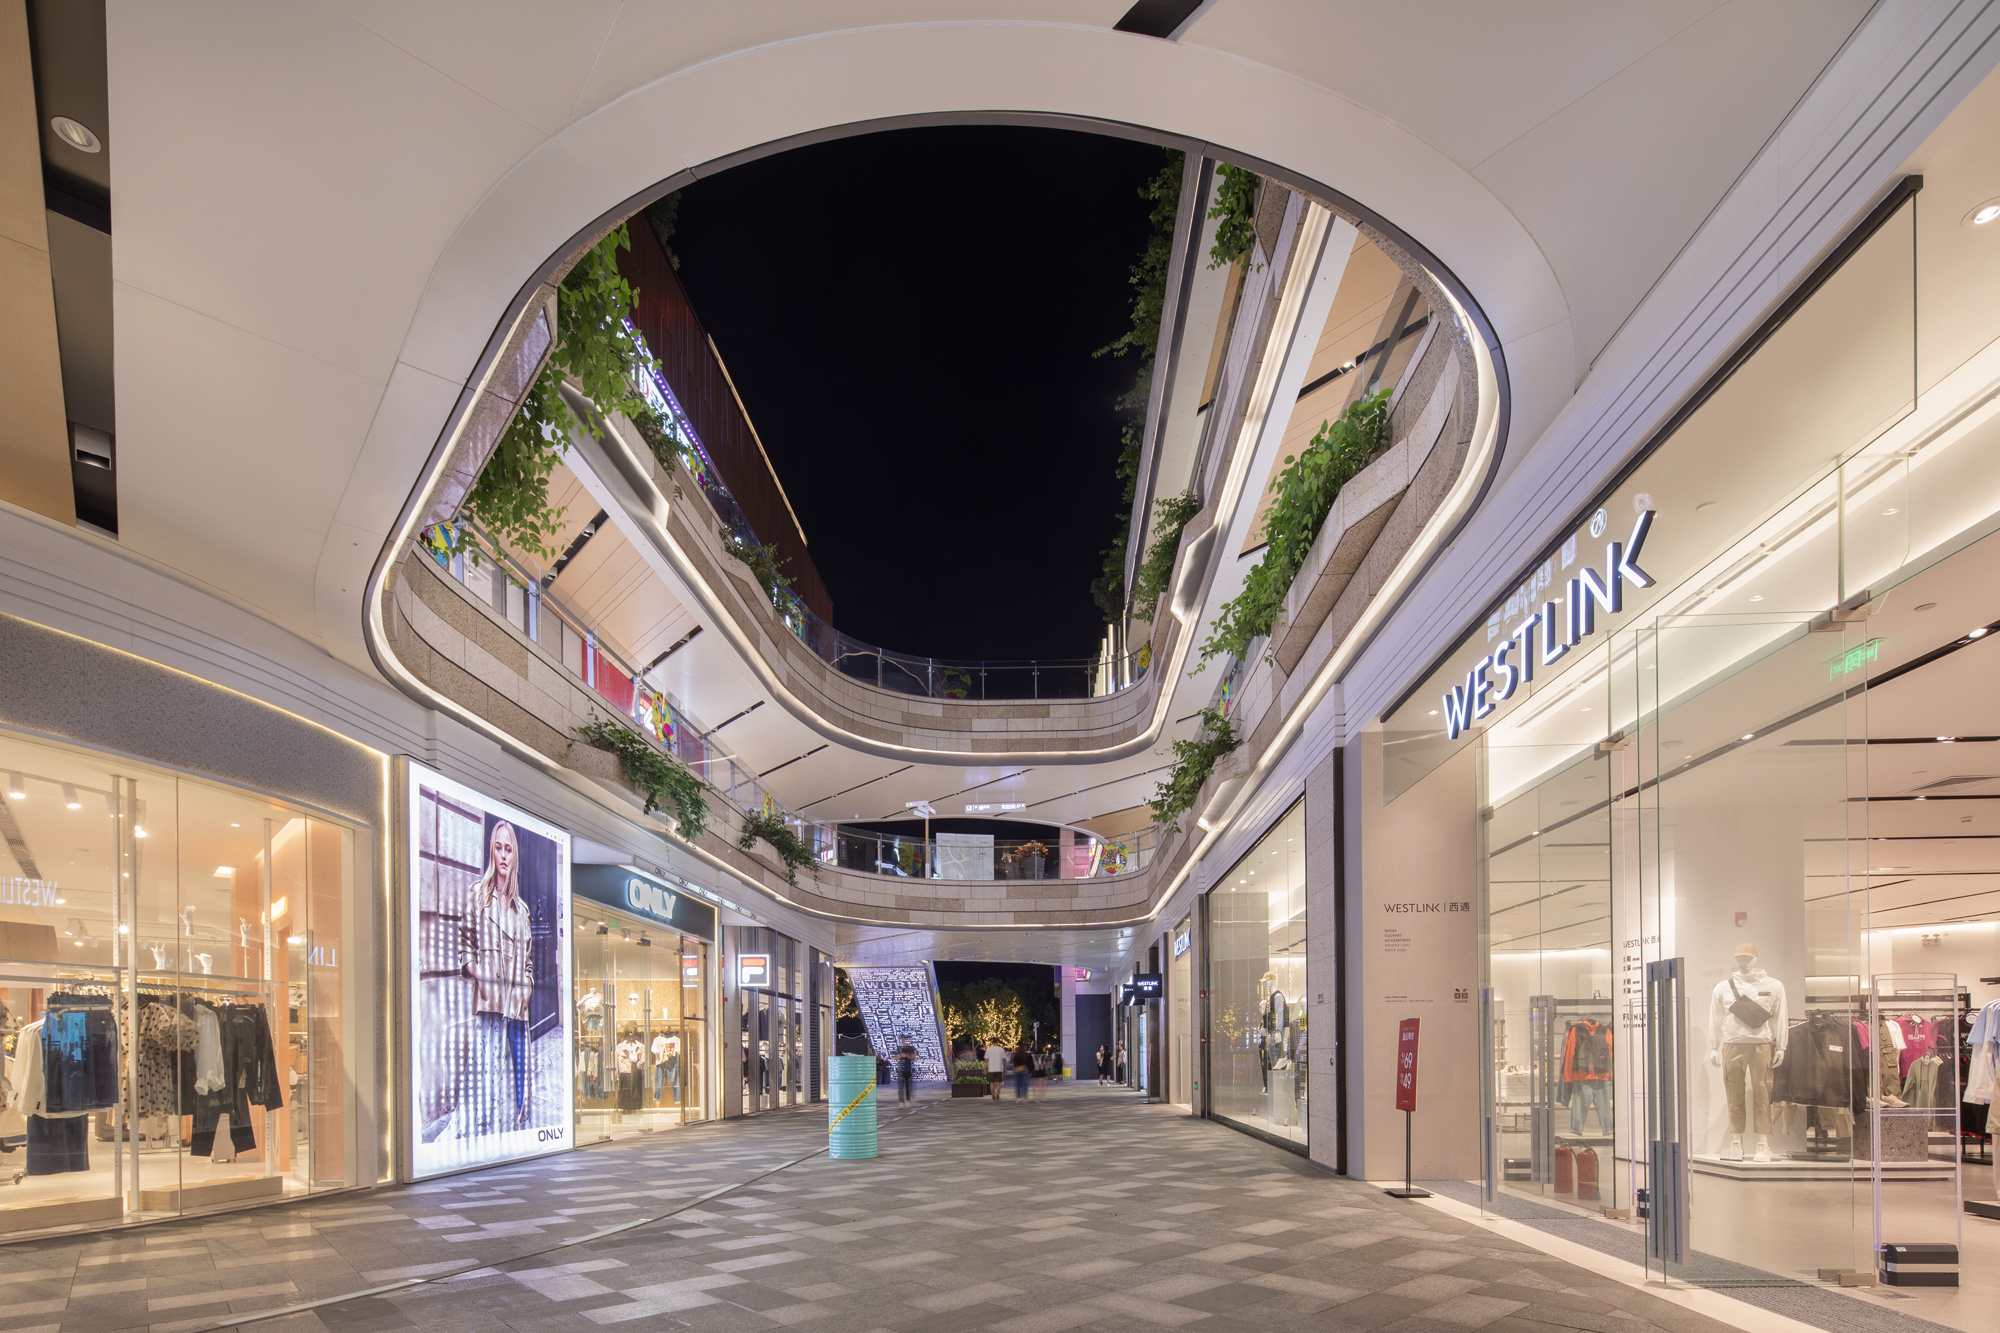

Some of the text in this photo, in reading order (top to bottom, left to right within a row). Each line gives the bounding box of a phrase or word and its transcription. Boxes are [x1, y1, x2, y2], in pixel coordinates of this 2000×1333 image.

[1442, 510, 1657, 740] WESTLINK
[654, 868, 666, 877] ONLY
[678, 877, 689, 887] ONLY
[629, 879, 676, 920] ONLY
[1384, 902, 1440, 913] WESTLINK
[538, 1127, 564, 1142] ONLY
